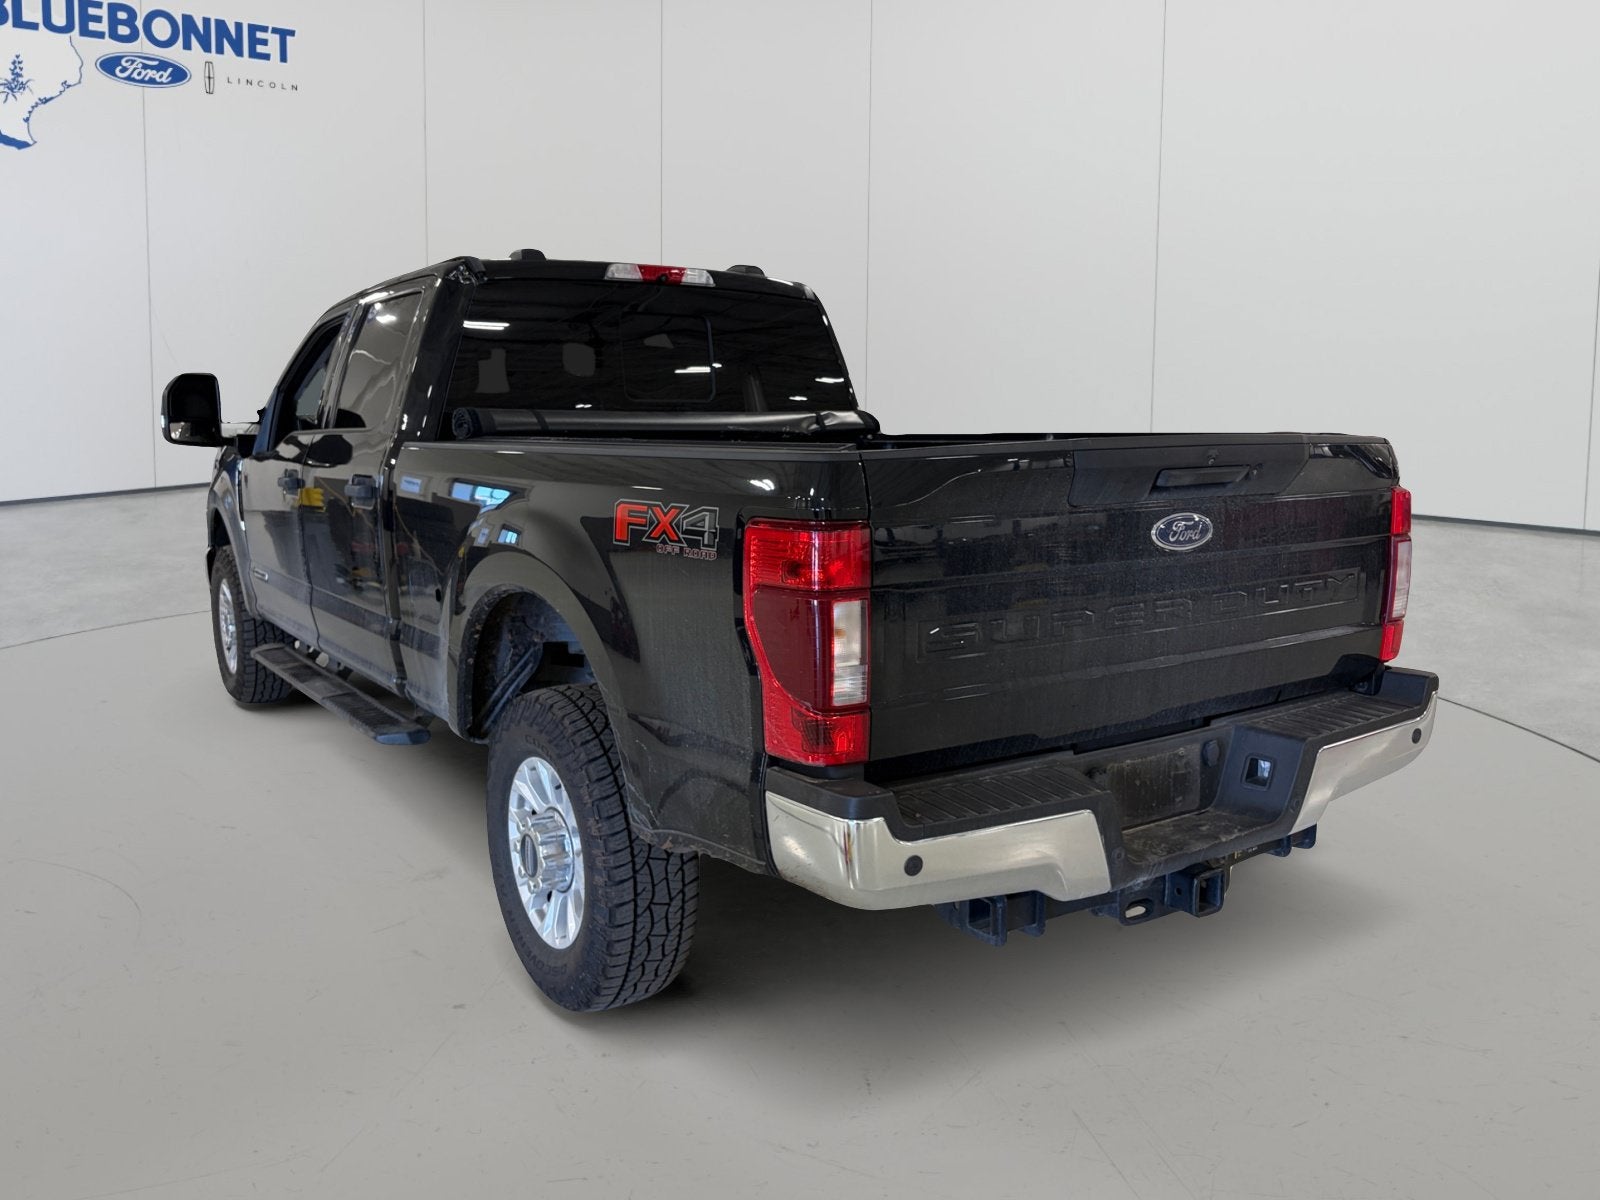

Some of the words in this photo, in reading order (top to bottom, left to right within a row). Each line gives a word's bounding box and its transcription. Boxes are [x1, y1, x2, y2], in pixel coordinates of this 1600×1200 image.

[0, 0, 296, 63] LUEBONNET
[115, 55, 173, 85] Ford
[227, 76, 298, 92] LINCOLN
[613, 499, 719, 551] FX4
[656, 543, 680, 556] OFF
[683, 547, 718, 561] ROAD
[924, 596, 1194, 653] SUPER
[1212, 573, 1355, 616] DUTY
